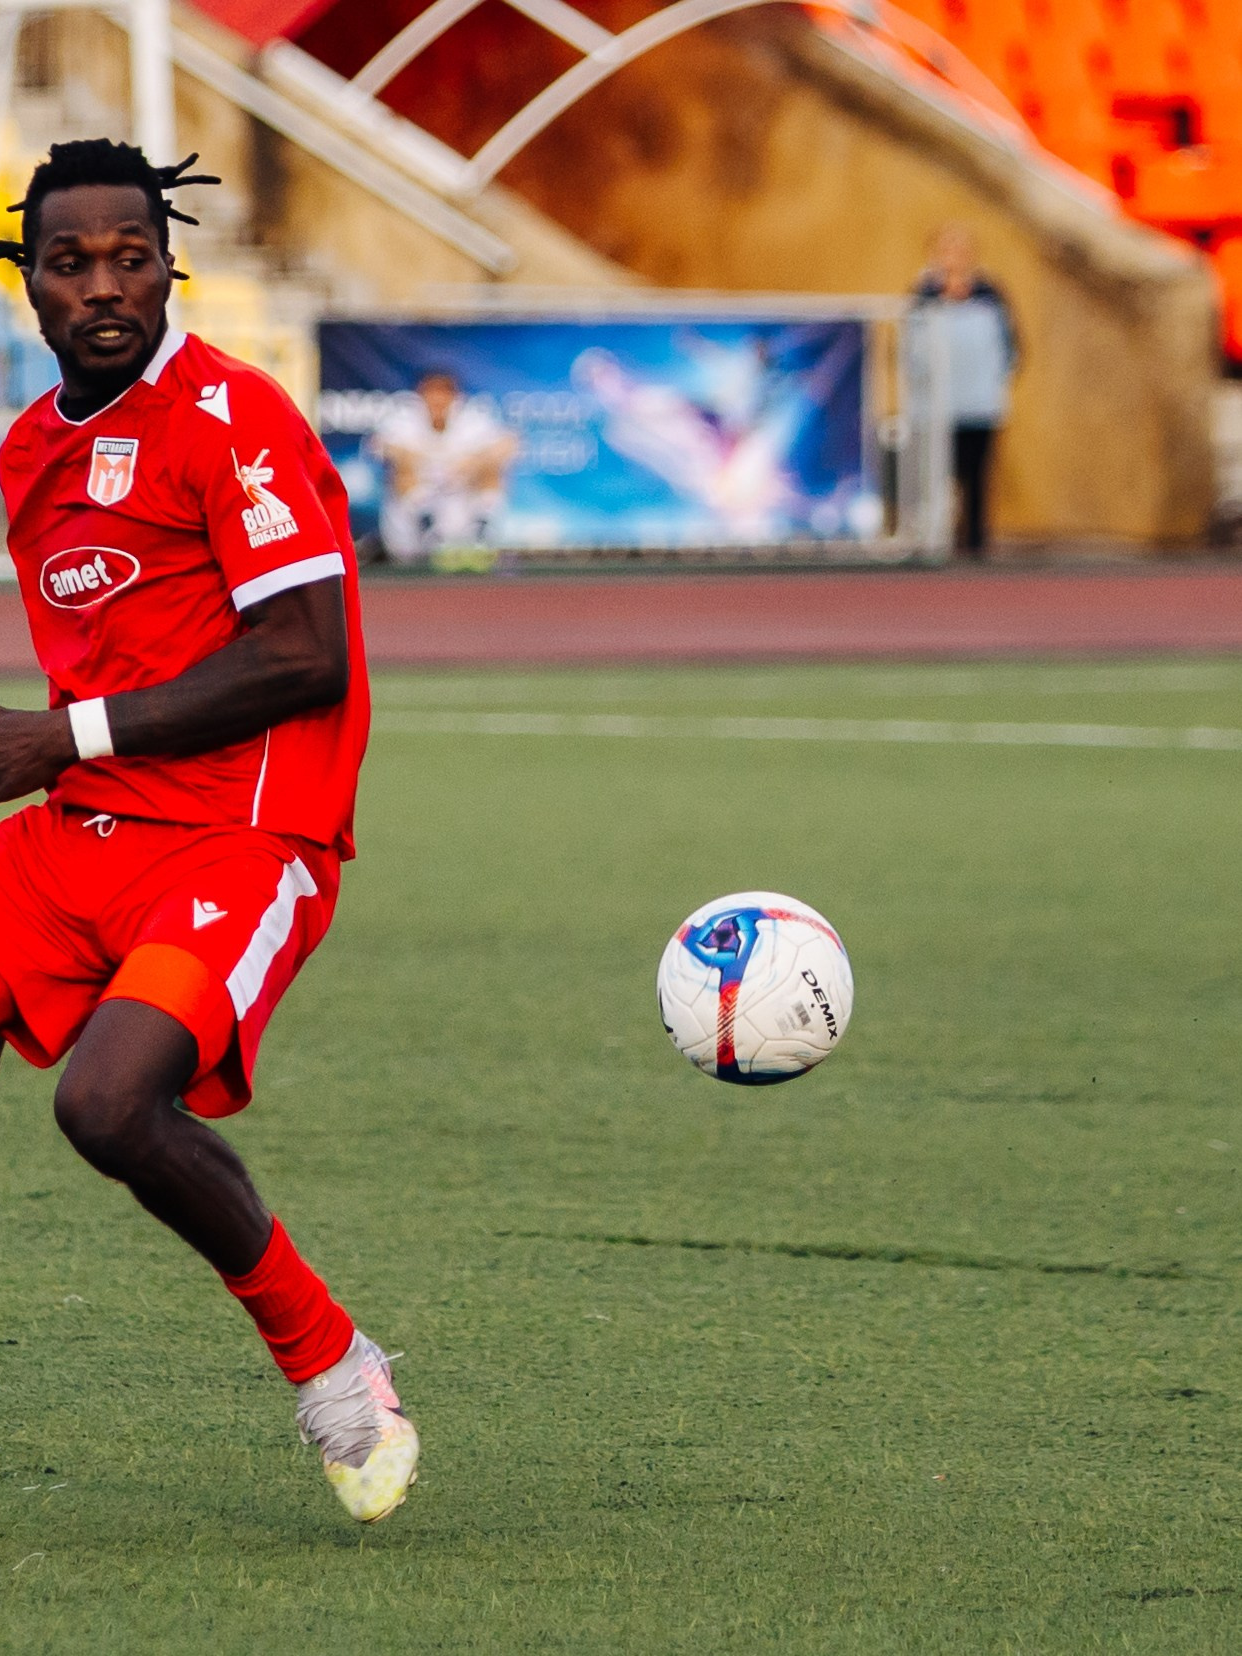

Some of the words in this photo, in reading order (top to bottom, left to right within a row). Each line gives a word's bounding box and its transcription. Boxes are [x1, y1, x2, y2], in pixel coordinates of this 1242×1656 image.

[241, 503, 270, 533] 80
[248, 519, 299, 549] ПОБЕДА!
[49, 553, 113, 598] amet
[800, 968, 838, 1041] DEMIX
